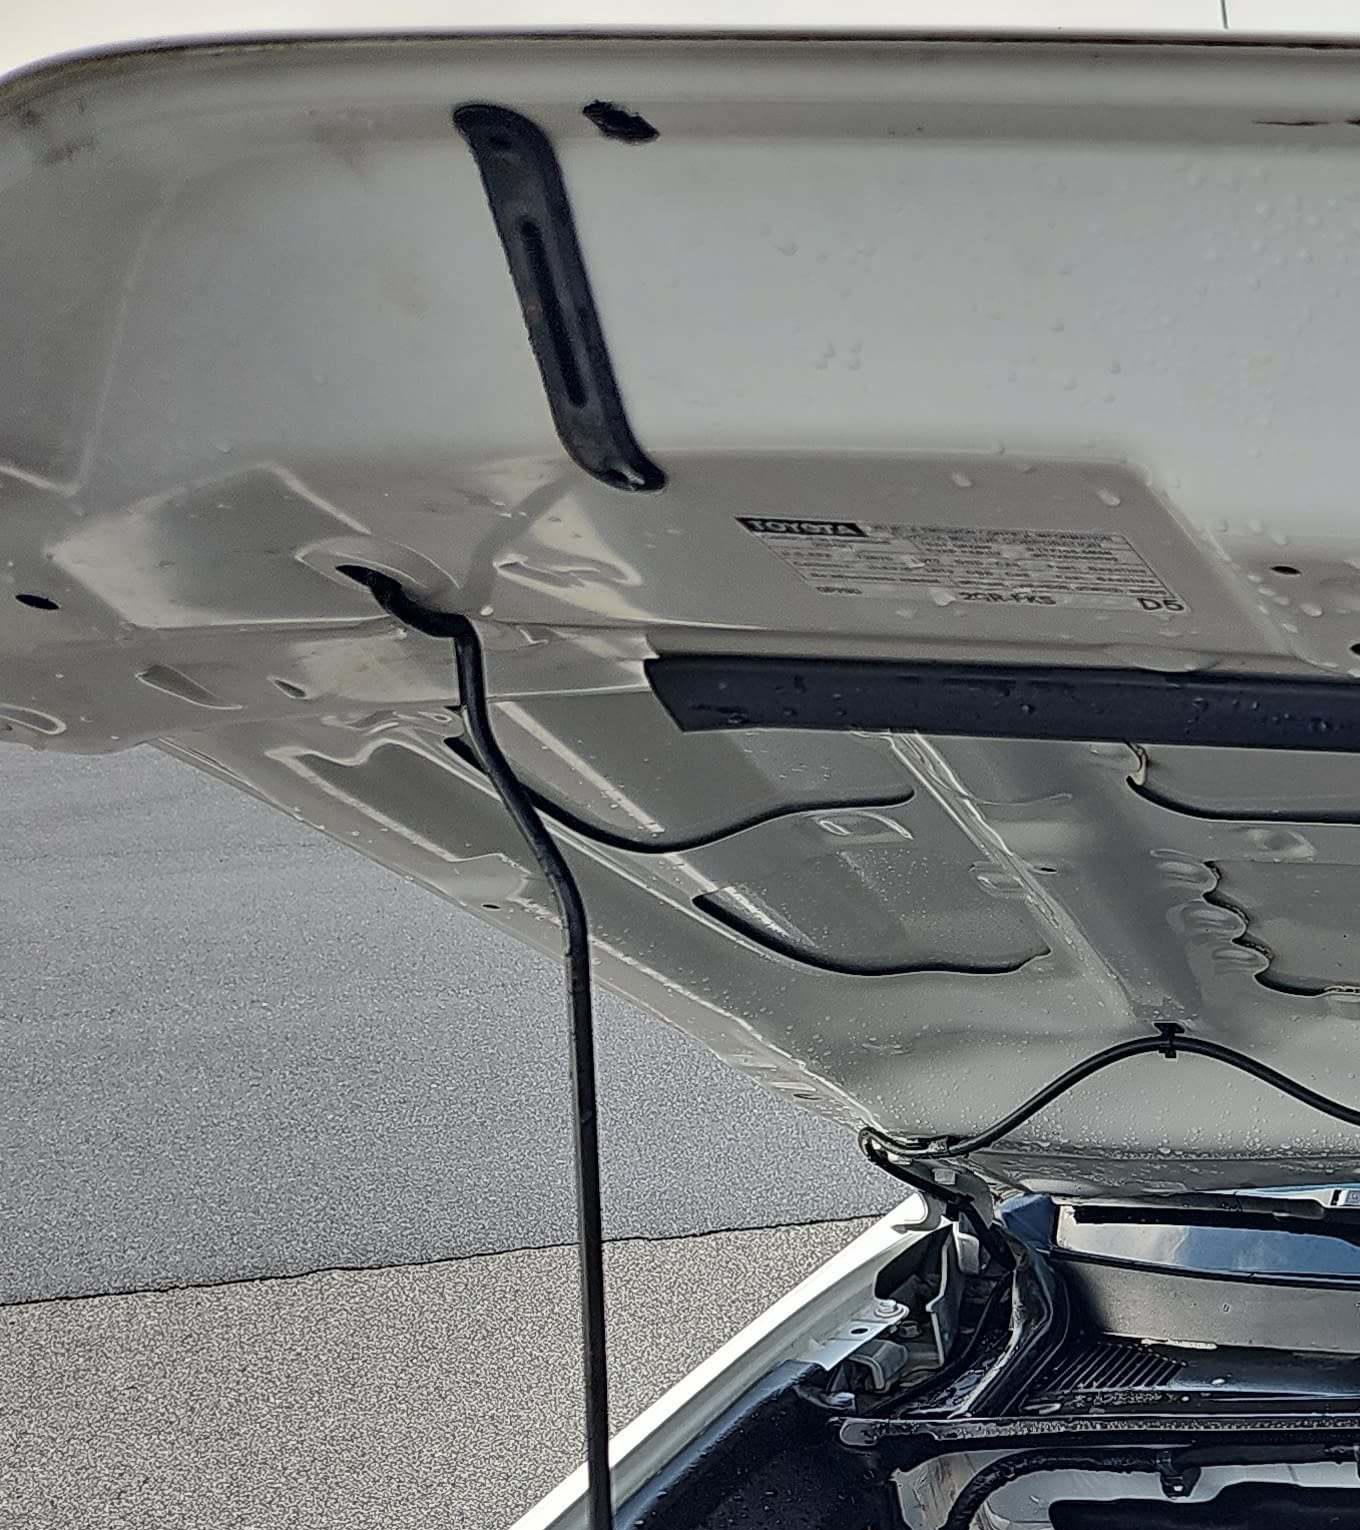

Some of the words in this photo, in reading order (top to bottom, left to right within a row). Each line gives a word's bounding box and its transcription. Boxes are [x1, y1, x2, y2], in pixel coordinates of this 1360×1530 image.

[748, 520, 859, 535] TOYOTA
[958, 592, 1057, 605] 2GR-FKS
[1137, 597, 1185, 612] D5
